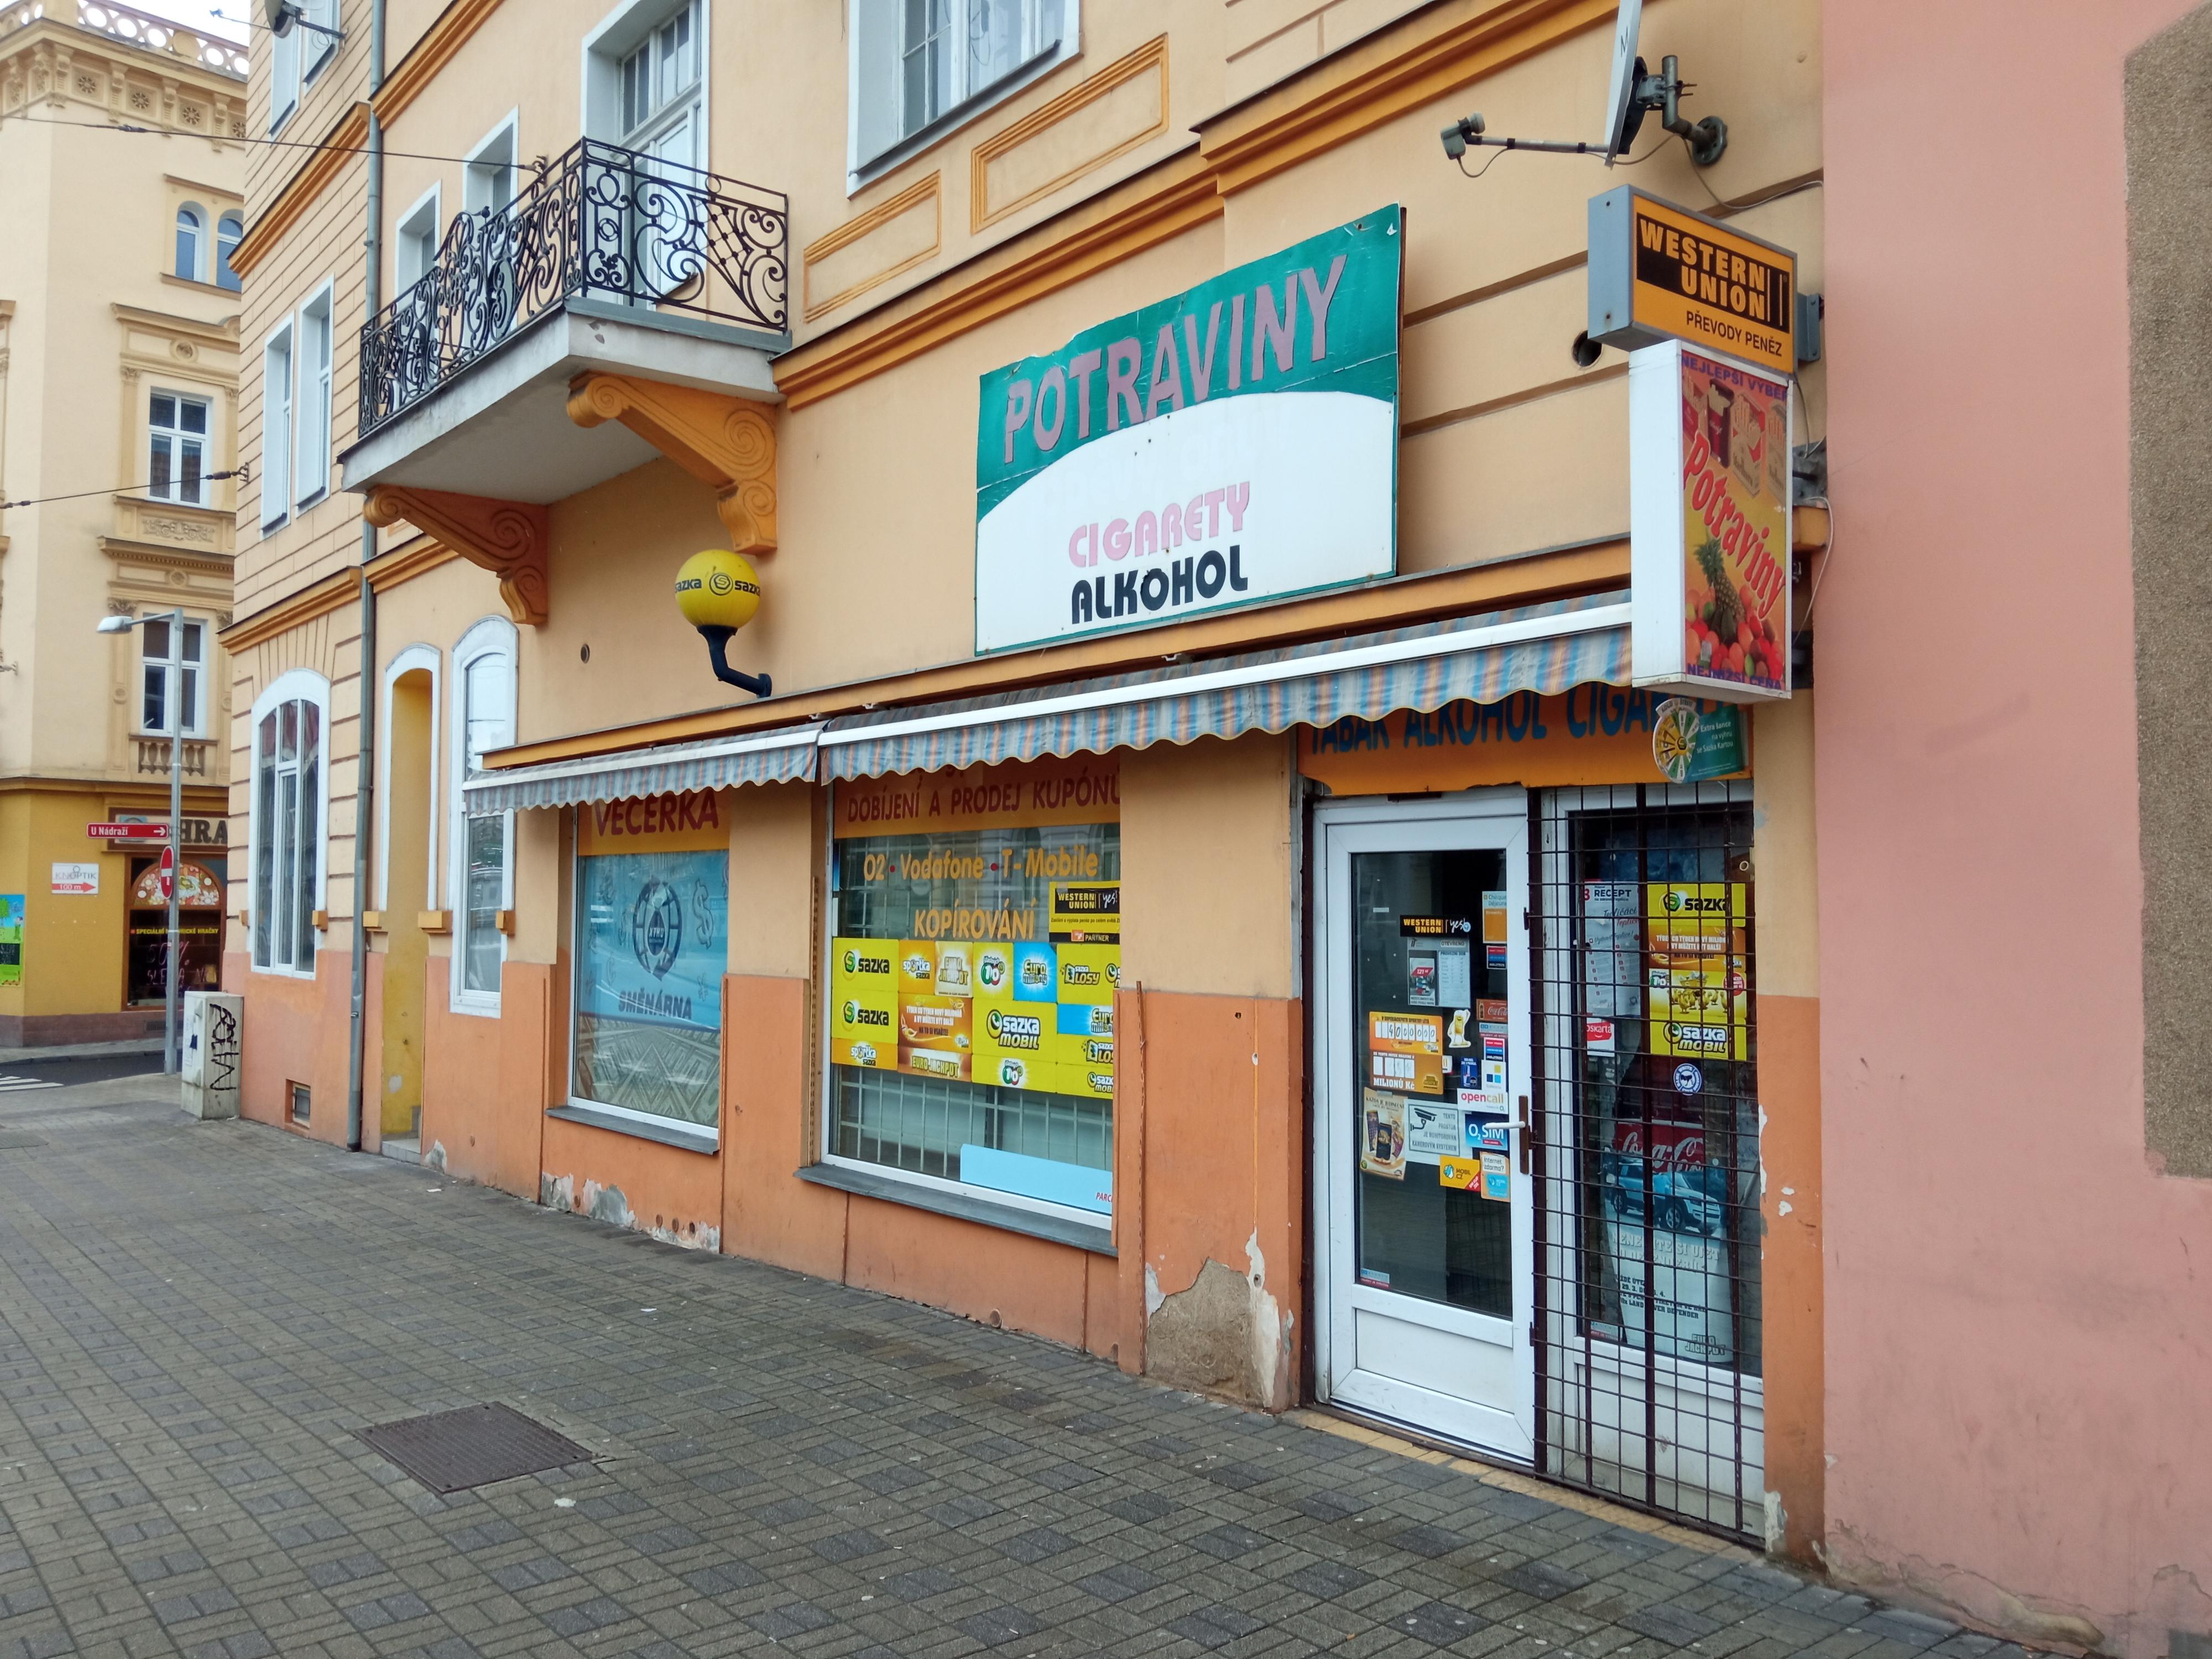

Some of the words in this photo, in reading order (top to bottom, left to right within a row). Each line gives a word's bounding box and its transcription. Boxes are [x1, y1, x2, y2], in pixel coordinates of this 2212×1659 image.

[1640, 218, 1765, 290] WESTERN
[1681, 265, 1765, 320] UNION
[1686, 310, 1742, 343] PŘEVODY
[1745, 331, 1782, 357] PENĚZ
[1004, 254, 1347, 463] POTRAVINY
[1069, 481, 1250, 567] CIGARETY
[1684, 431, 1786, 620] Potraviny
[1072, 545, 1248, 624] ALKOHOL
[1700, 723, 1714, 732] Extra
[1716, 721, 1731, 729] šance
[1719, 731, 1733, 740] výhru
[929, 797, 940, 817] A
[951, 783, 1020, 815] PRODEJ
[91, 827, 97, 835] U
[98, 826, 128, 836] Nádraží
[863, 852, 885, 881] O2
[900, 849, 984, 880] Vodafone
[1058, 893, 1094, 901] WESTERN
[1102, 890, 1118, 909] yes!
[915, 897, 1036, 939] KOPÍROVÁNÍ
[1024, 959, 1046, 974] Euro
[1074, 972, 1100, 985] LOSY
[618, 987, 692, 1020] SMĚNÁRNA
[1096, 1075, 1113, 1085] sazk
[1373, 1077, 1404, 1089] MILIONŮ
[1461, 1092, 1504, 1104] opencall
[1482, 1124, 1504, 1140] SIM
[1629, 1300, 1644, 1308] LAND
